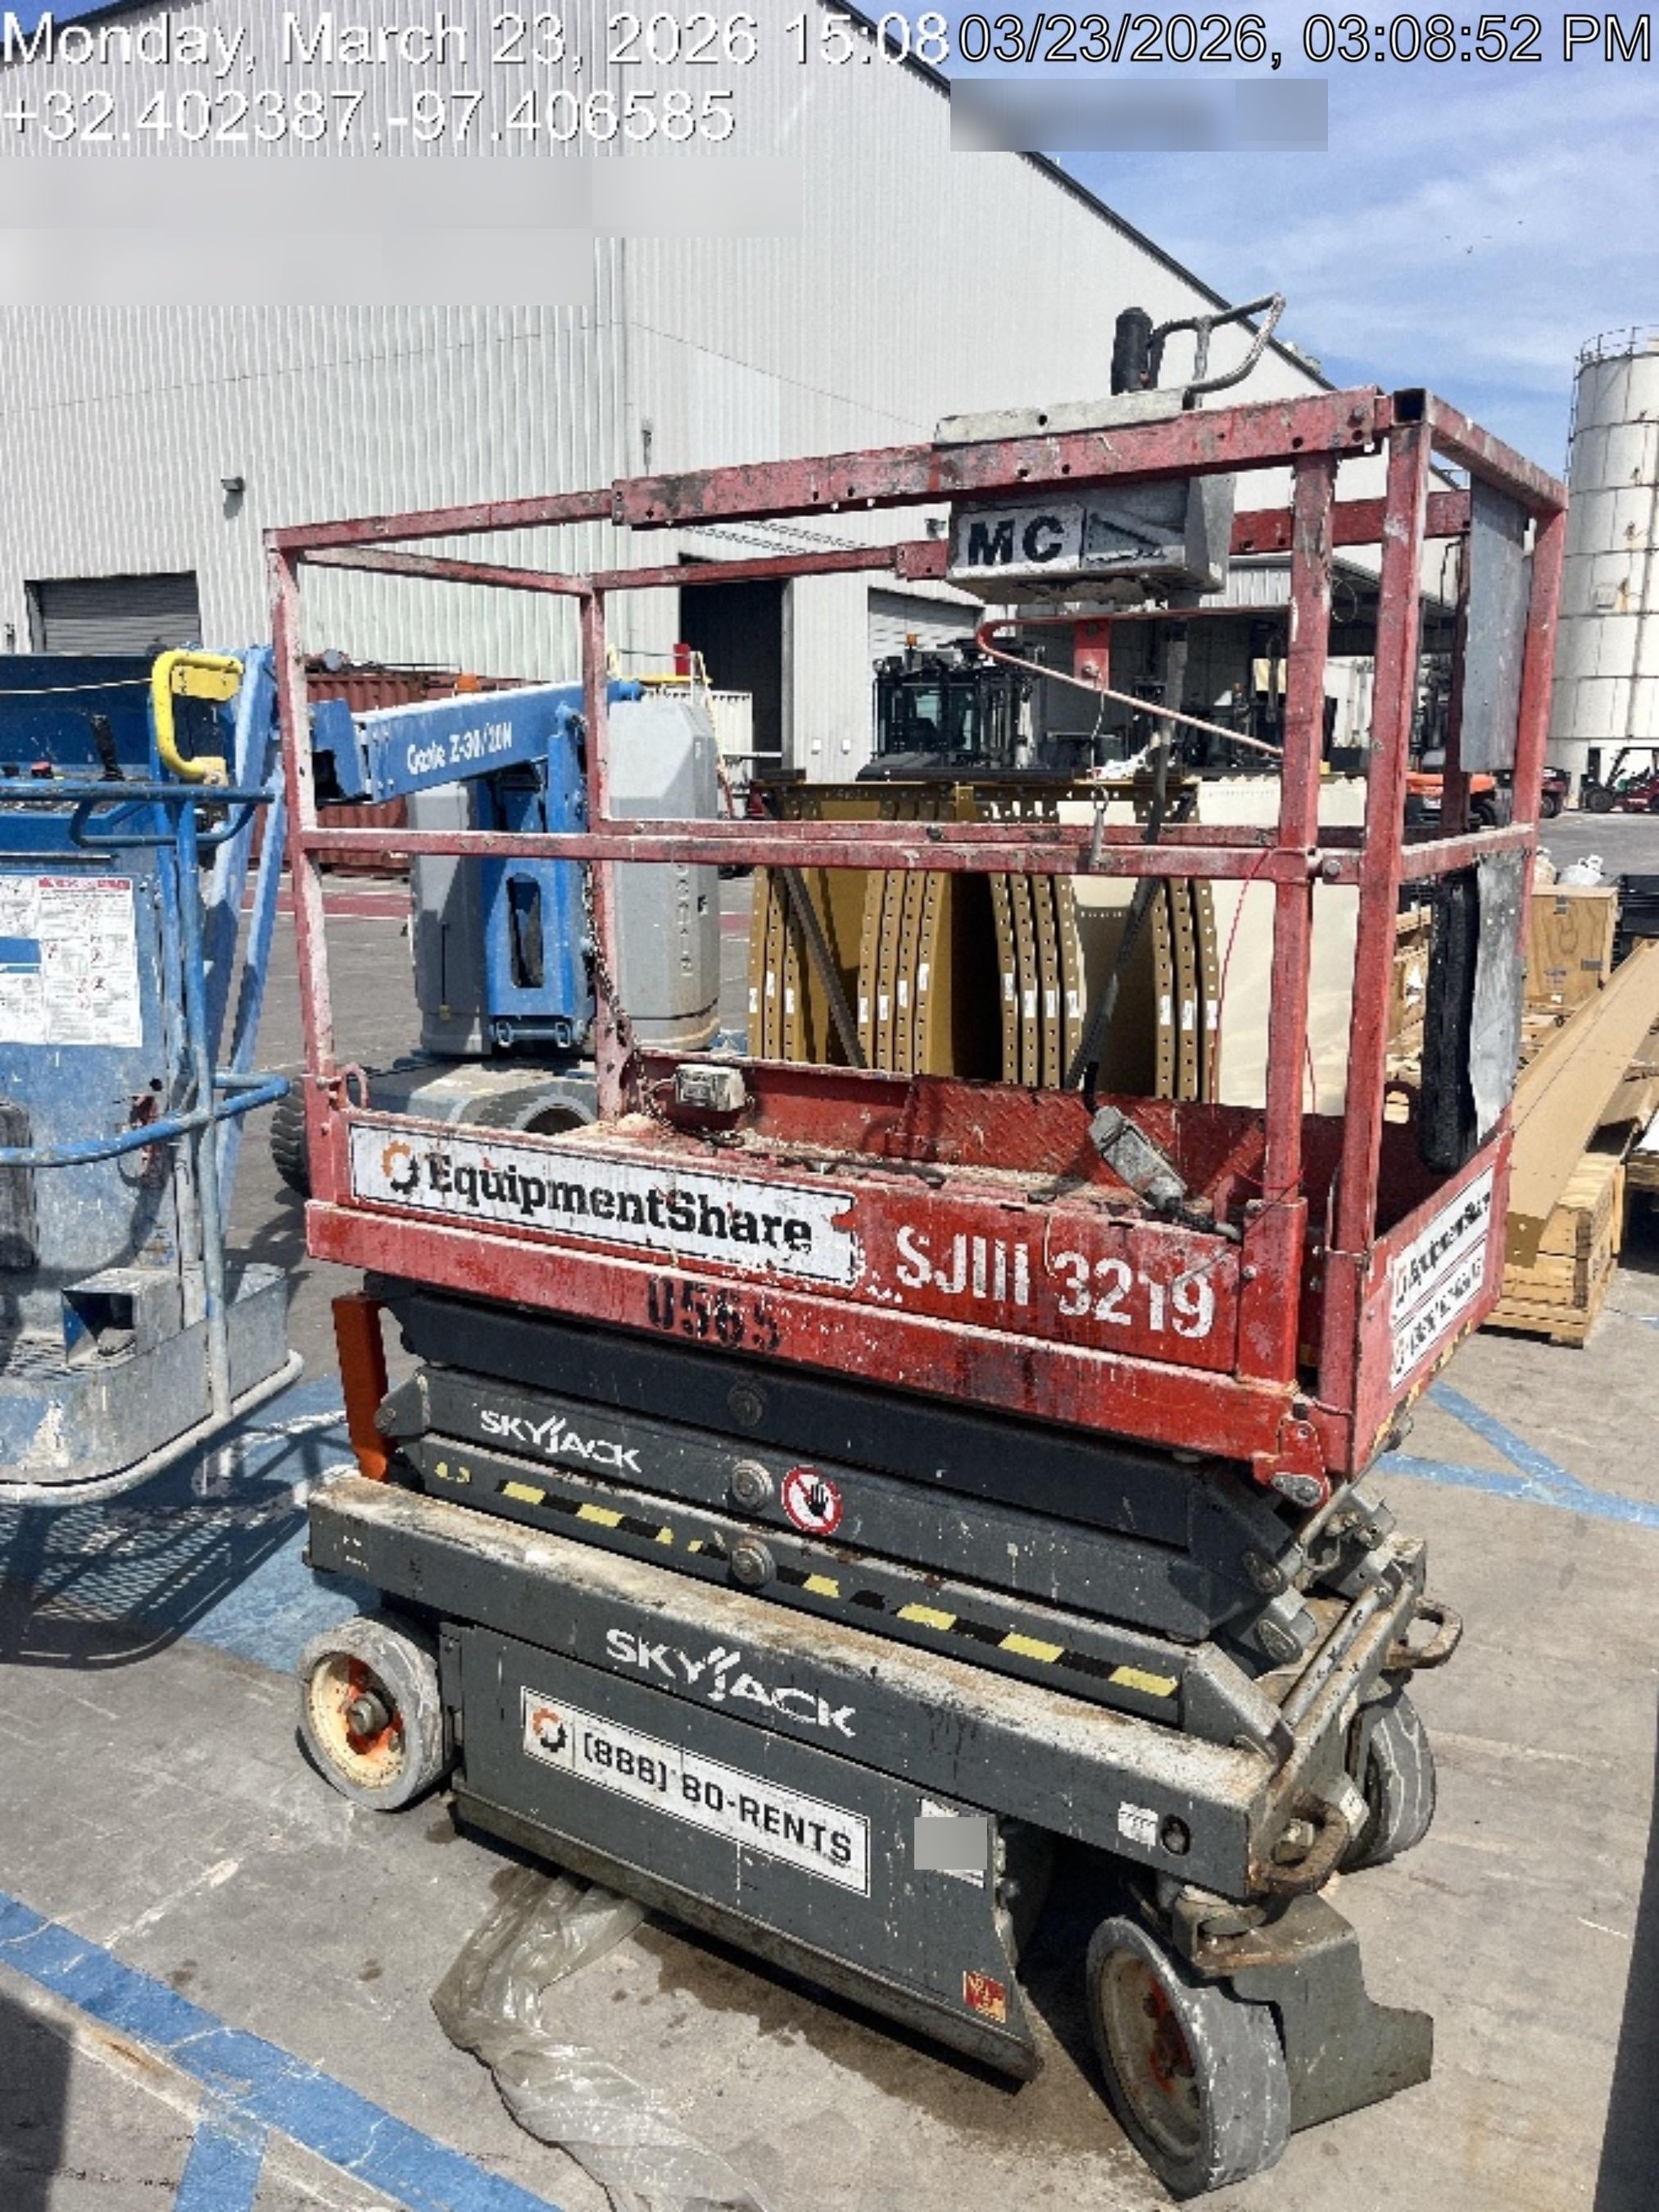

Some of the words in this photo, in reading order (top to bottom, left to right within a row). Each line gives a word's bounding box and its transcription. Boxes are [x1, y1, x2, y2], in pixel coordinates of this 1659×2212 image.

[968, 515, 1064, 564] MC
[428, 1152, 812, 1254] EquipmentShare
[1051, 1249, 1216, 1339] 3219
[480, 1409, 643, 1474] SKYJACK
[605, 1628, 857, 1738] SKYJACK
[682, 1772, 852, 1863] 80-RENTS
